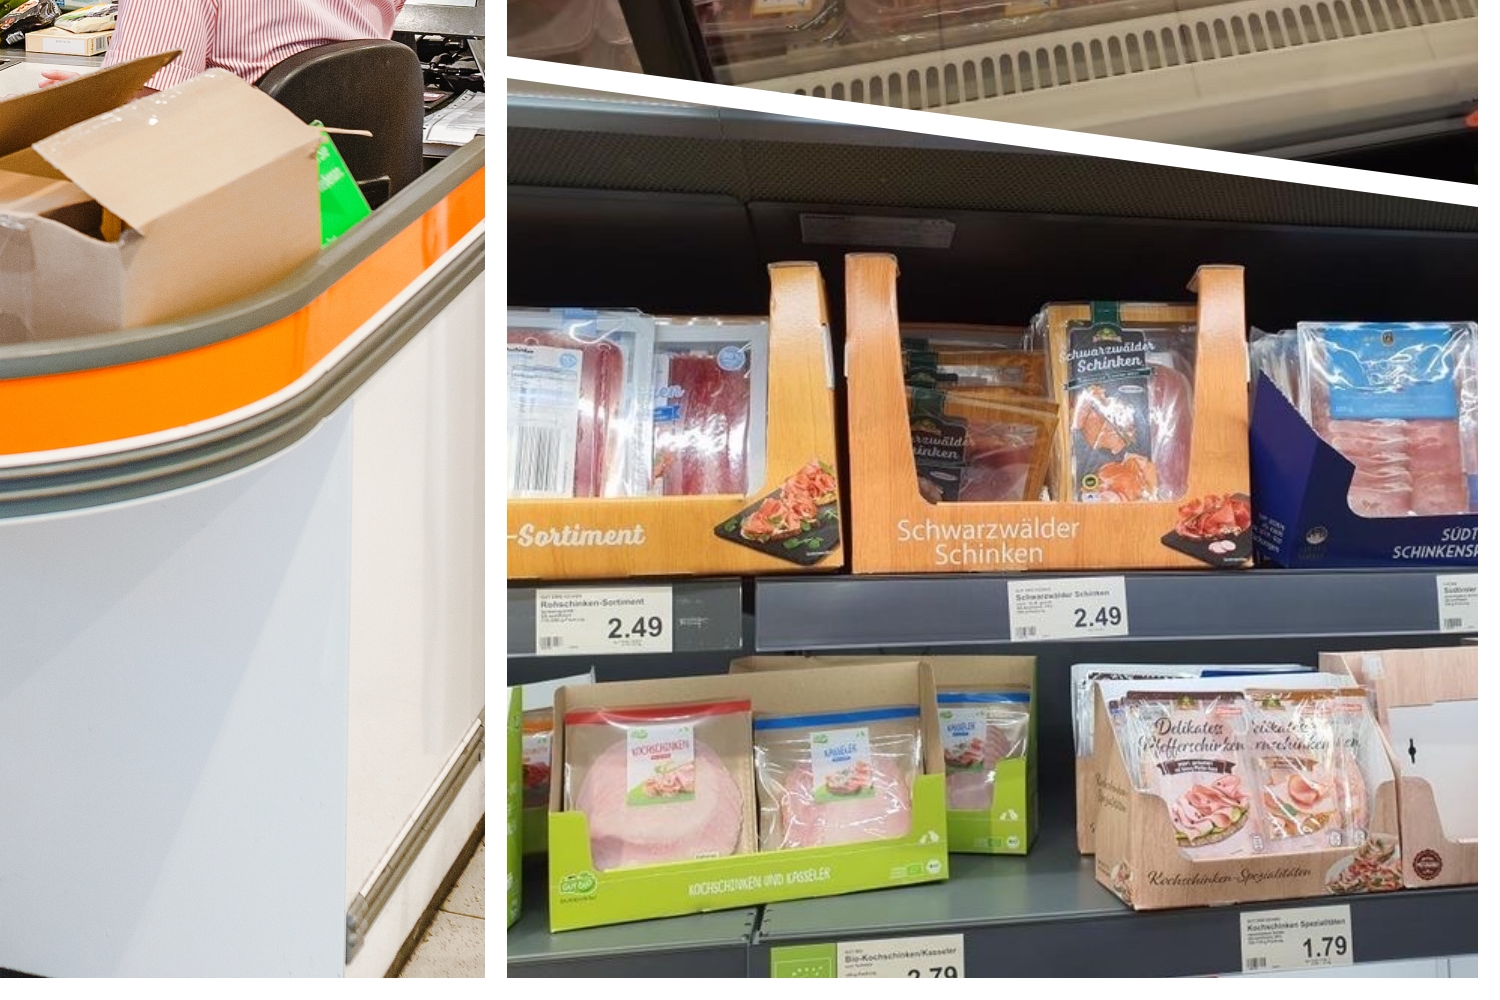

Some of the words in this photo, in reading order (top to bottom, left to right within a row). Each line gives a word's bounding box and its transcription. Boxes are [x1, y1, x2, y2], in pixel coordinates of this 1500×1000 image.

[1058, 341, 1156, 363] Schwarzwälder
[1077, 355, 1143, 374] Schinken
[897, 517, 1080, 542] Schwarzwälder
[1441, 526, 1478, 542] SÜDT
[935, 542, 1044, 565] Schinken
[540, 598, 645, 609] Rohschinken-Sortiment
[1016, 591, 1072, 602] Schwarzwälder
[1074, 589, 1110, 599] Schinken
[1074, 605, 1122, 628] 2.49
[607, 616, 663, 640] 2.49
[688, 875, 763, 896] KOCHSCHINKEN
[764, 873, 784, 886] UND
[787, 867, 832, 884] KASSELER
[1147, 866, 1312, 887] Kochschinken-Spezialitäten
[1247, 921, 1299, 932] Kochschinken
[844, 947, 957, 963] Bio-Kochschinken/Kasseler
[1303, 935, 1348, 959] 1.79
[907, 966, 958, 978] 279
